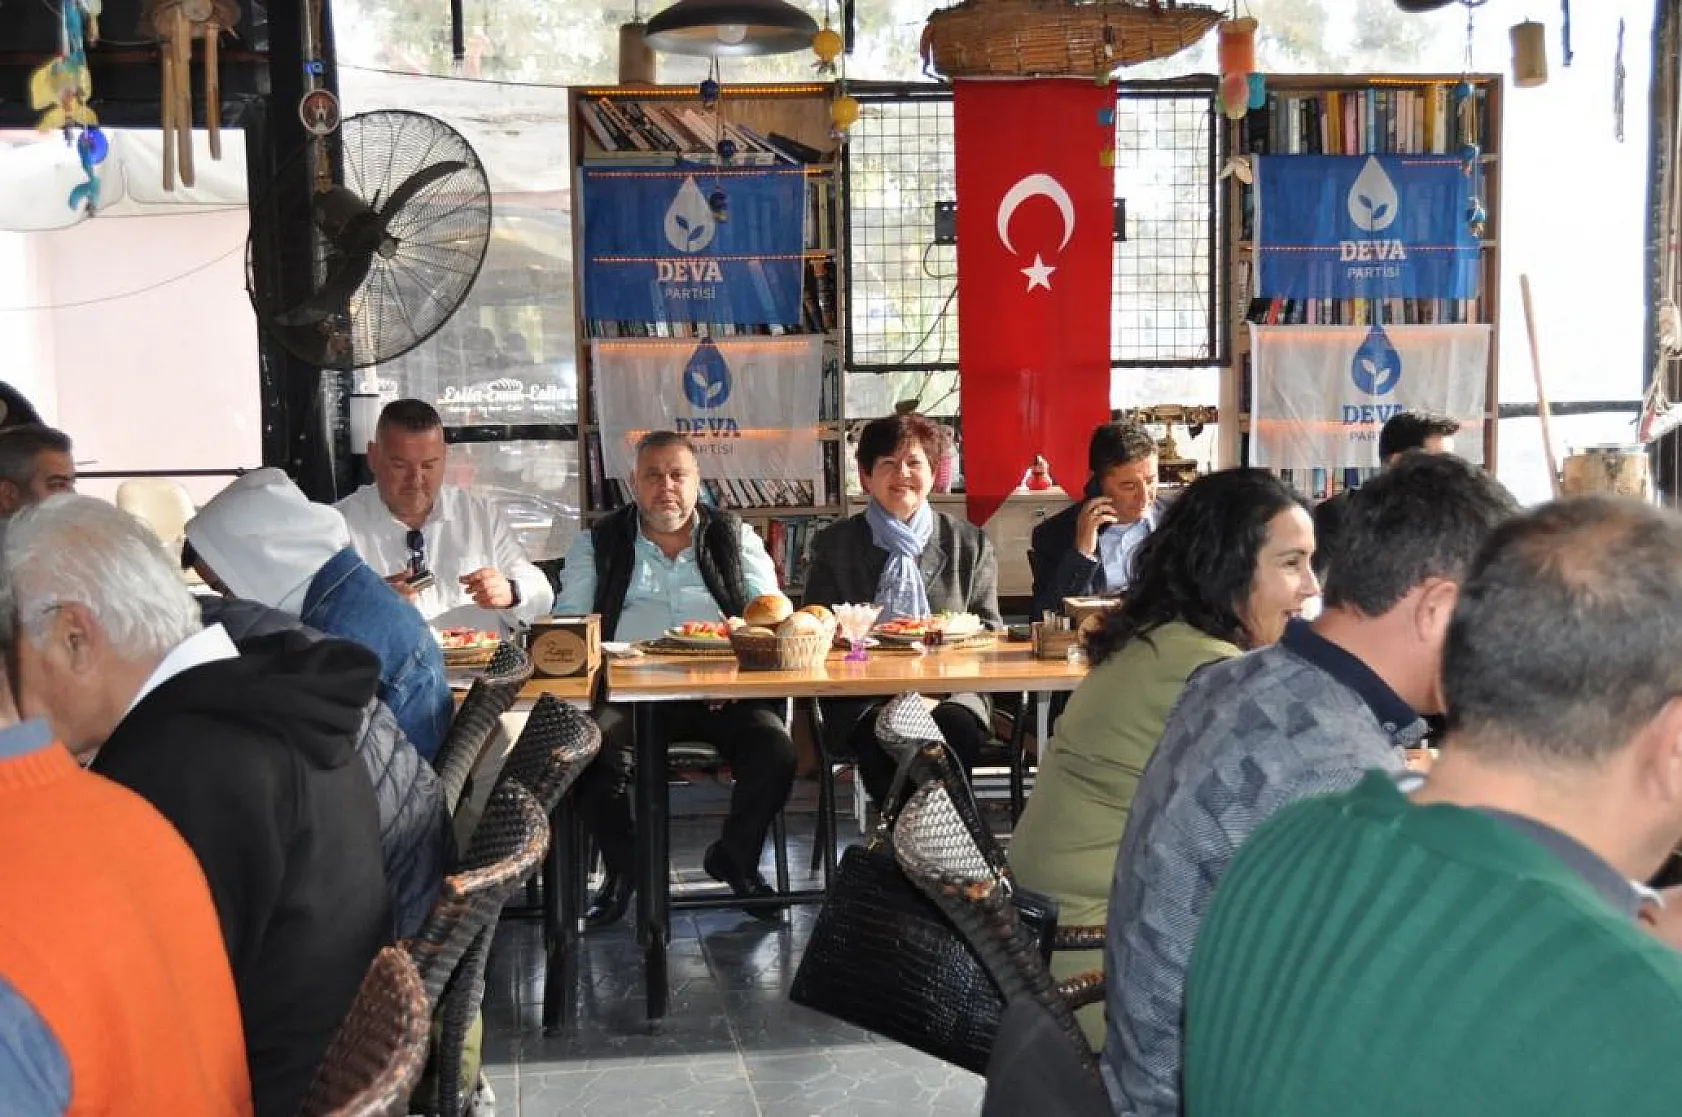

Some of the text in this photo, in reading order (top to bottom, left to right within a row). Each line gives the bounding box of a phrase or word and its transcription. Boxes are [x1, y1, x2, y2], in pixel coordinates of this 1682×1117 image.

[1339, 239, 1407, 261] DEVA
[656, 260, 724, 282] DEVA
[674, 417, 741, 438] DEVA
